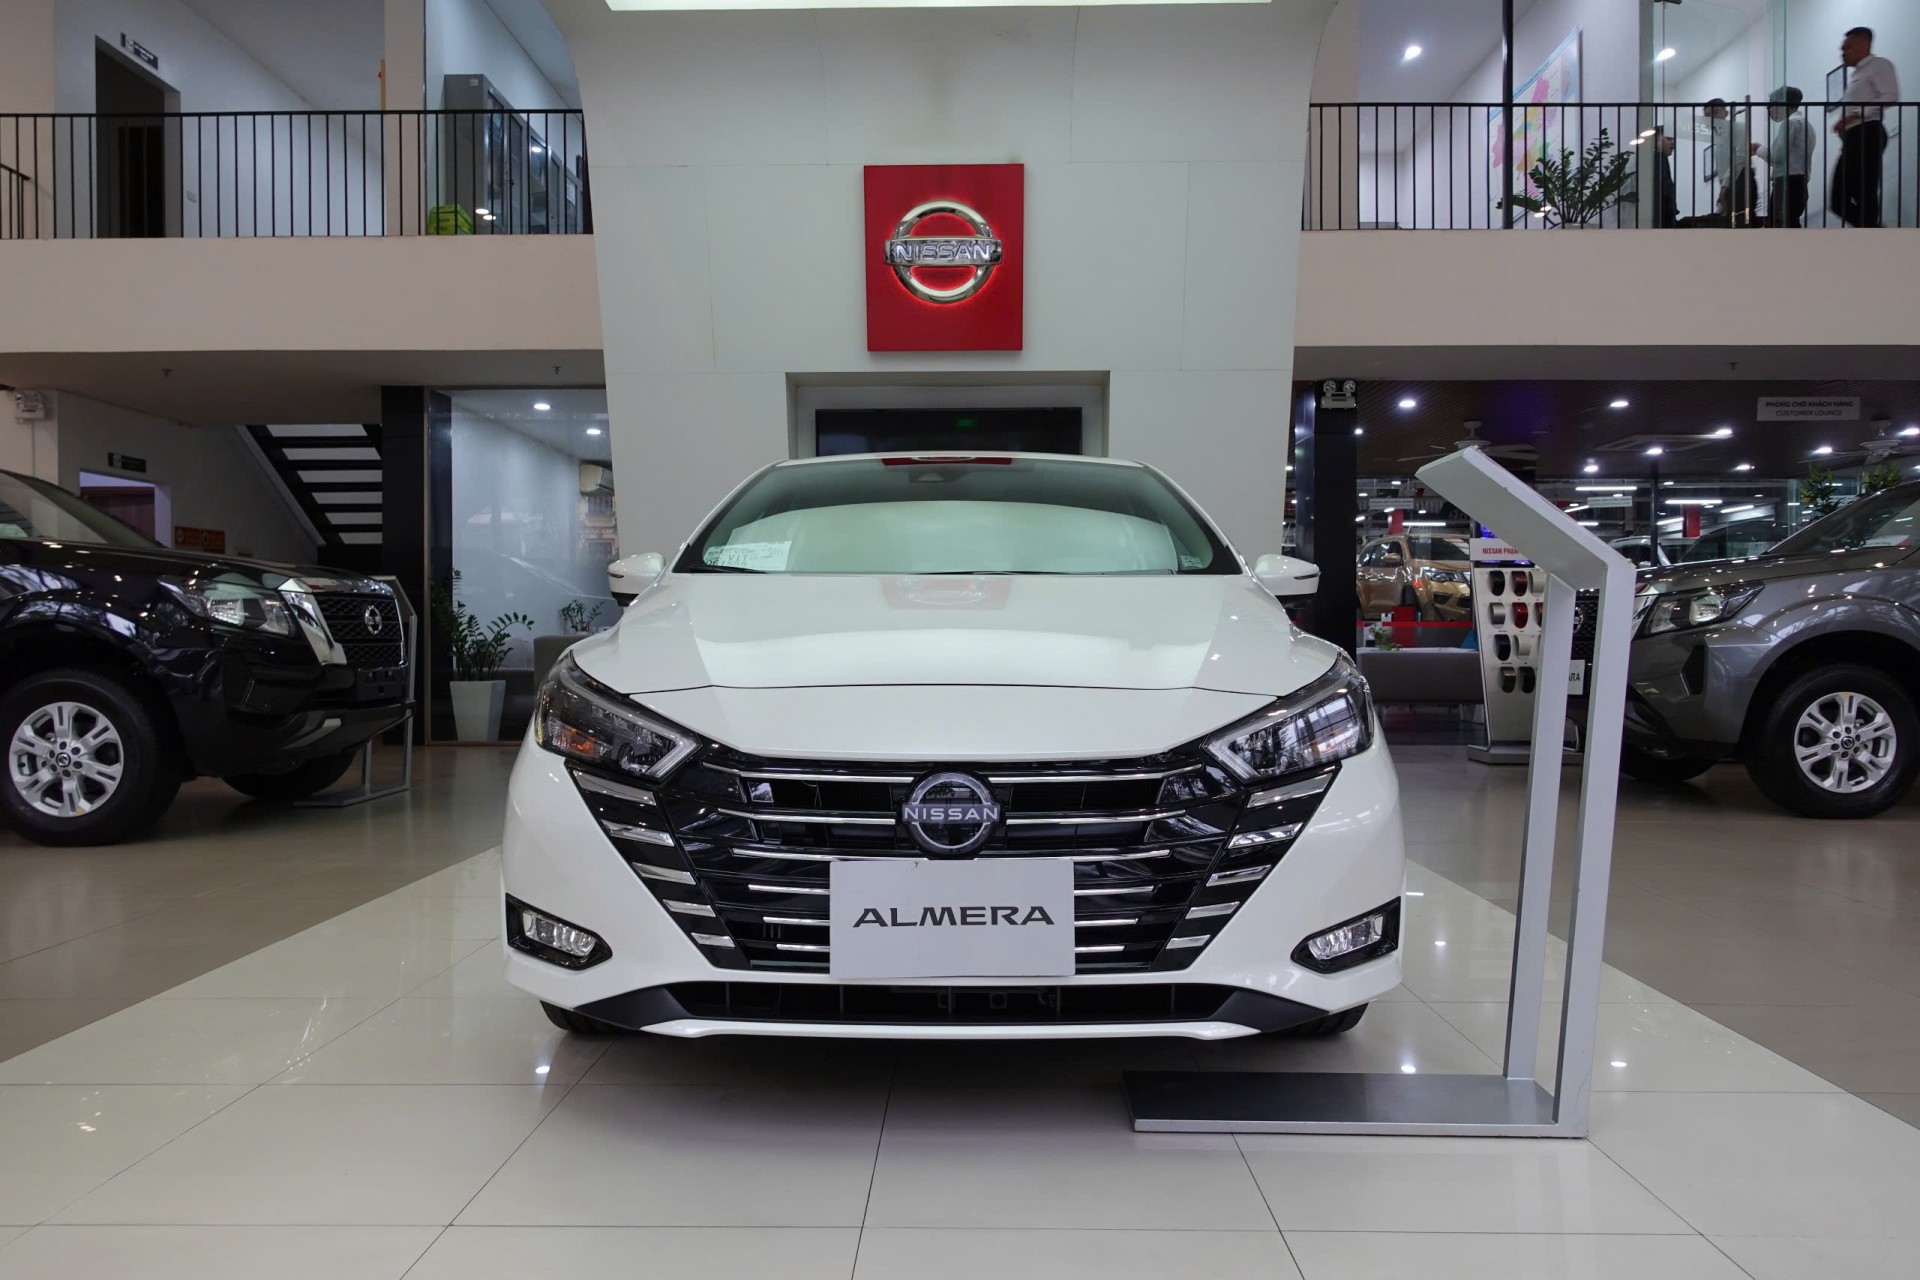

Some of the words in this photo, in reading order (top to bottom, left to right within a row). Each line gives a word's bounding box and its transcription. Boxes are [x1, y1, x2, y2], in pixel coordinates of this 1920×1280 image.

[895, 243, 990, 261] NISSAN
[1776, 409, 1813, 417] CUSTOMER
[1814, 409, 1843, 417] LOUNGE
[1482, 547, 1503, 555] NISSAN
[904, 807, 998, 821] NISSAN
[852, 905, 1056, 928] ALMERA
